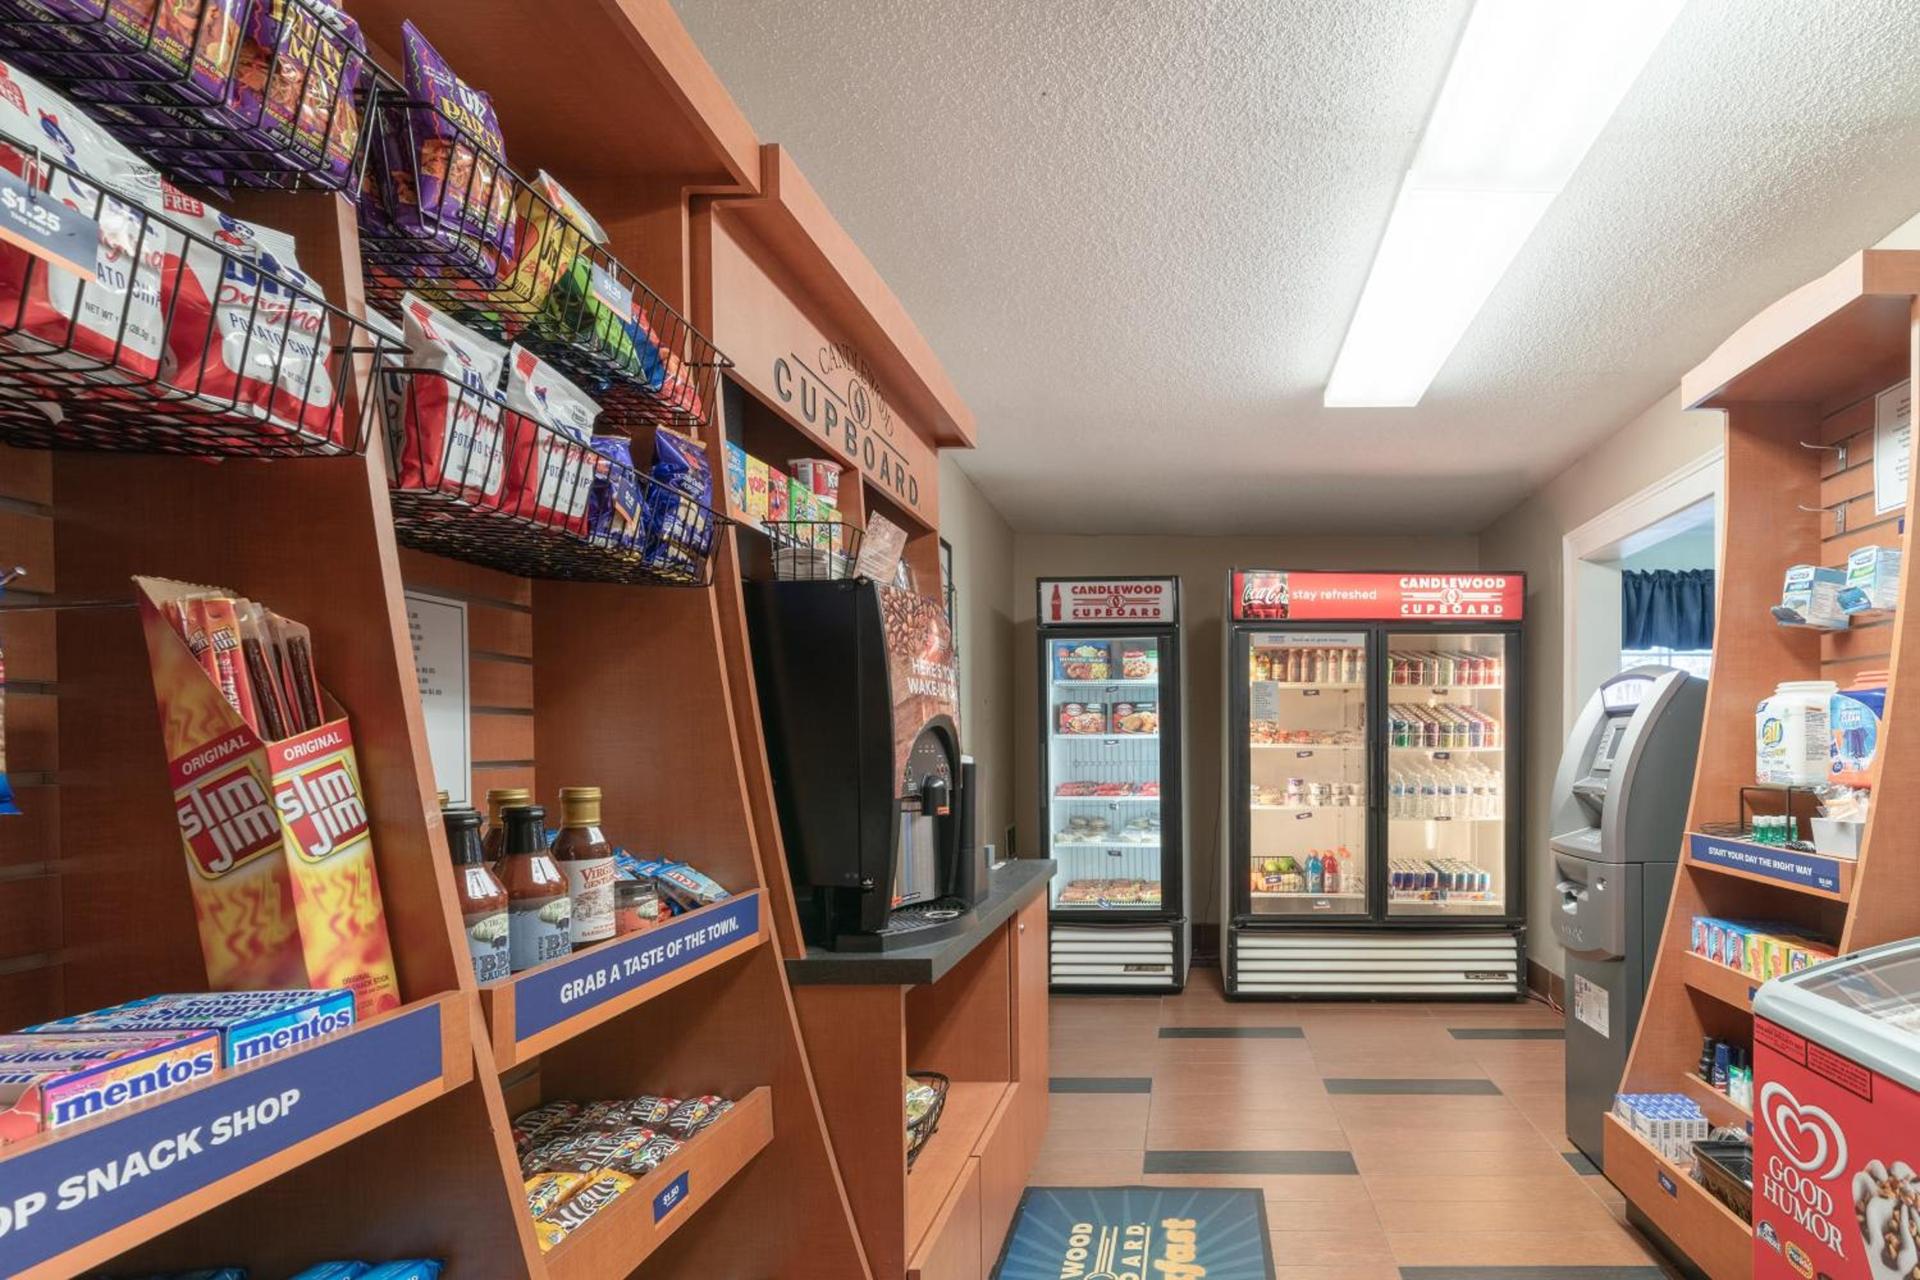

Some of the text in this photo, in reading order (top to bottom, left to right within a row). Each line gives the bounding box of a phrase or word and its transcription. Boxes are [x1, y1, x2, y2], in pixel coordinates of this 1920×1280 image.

[0, 186, 61, 233] $1.25
[164, 193, 202, 216] FREE
[85, 301, 101, 314] NET
[101, 308, 114, 320] WT
[220, 284, 323, 335] Origina
[773, 357, 918, 506] CUPBOARD
[1071, 584, 1164, 595] CANDLEWOOD
[1292, 588, 1317, 602] stay
[1319, 587, 1377, 600] refreshed
[1400, 577, 1506, 589] CANDLEWOOD
[1072, 607, 1162, 617] CUPBOARD
[1400, 603, 1504, 615] CUPBOARD
[181, 733, 250, 776] ORIGINAL
[283, 731, 343, 763] ORIGINAL
[580, 862, 616, 880] VIRG
[1744, 853, 1758, 865] DAY
[1758, 855, 1772, 868] THE
[1771, 858, 1795, 873] RIGHT
[1794, 864, 1813, 877] WAY
[480, 949, 510, 973] BB
[560, 916, 740, 1004] GRAB A TASTE OF THE TOWN.
[233, 1008, 349, 1063] mentos
[54, 1052, 217, 1125] mentos
[57, 1127, 205, 1211] SNACK
[210, 1088, 301, 1147] SHOP
[1768, 1155, 1834, 1216] GOOD
[1763, 1172, 1847, 1258] HUMOR
[1060, 1222, 1094, 1280] WOOD
[1118, 1224, 1145, 1280] OARD
[1153, 1217, 1206, 1280] fast
